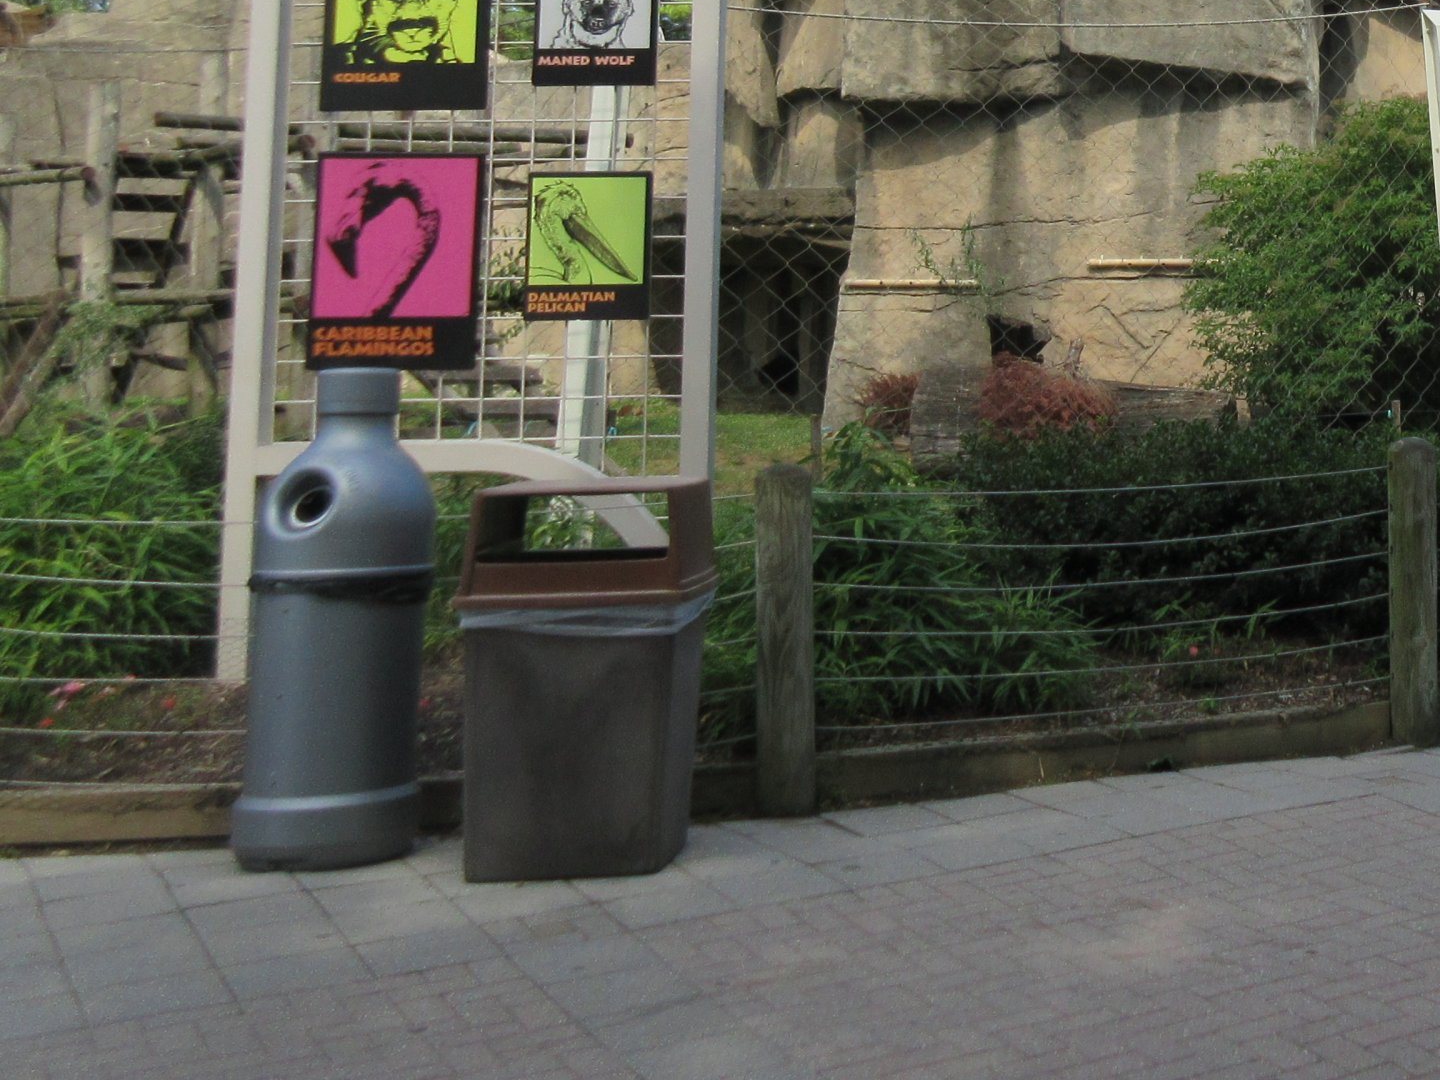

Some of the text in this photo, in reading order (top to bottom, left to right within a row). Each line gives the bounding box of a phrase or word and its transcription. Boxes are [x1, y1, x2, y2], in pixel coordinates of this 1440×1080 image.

[538, 55, 635, 66] MANED WOLF
[334, 72, 400, 83] COUGAR
[528, 292, 615, 302] DALMATIAN
[527, 302, 587, 313] PELICAN
[314, 326, 434, 341] CARIBBEAN
[312, 341, 434, 357] FLAMINGOS
